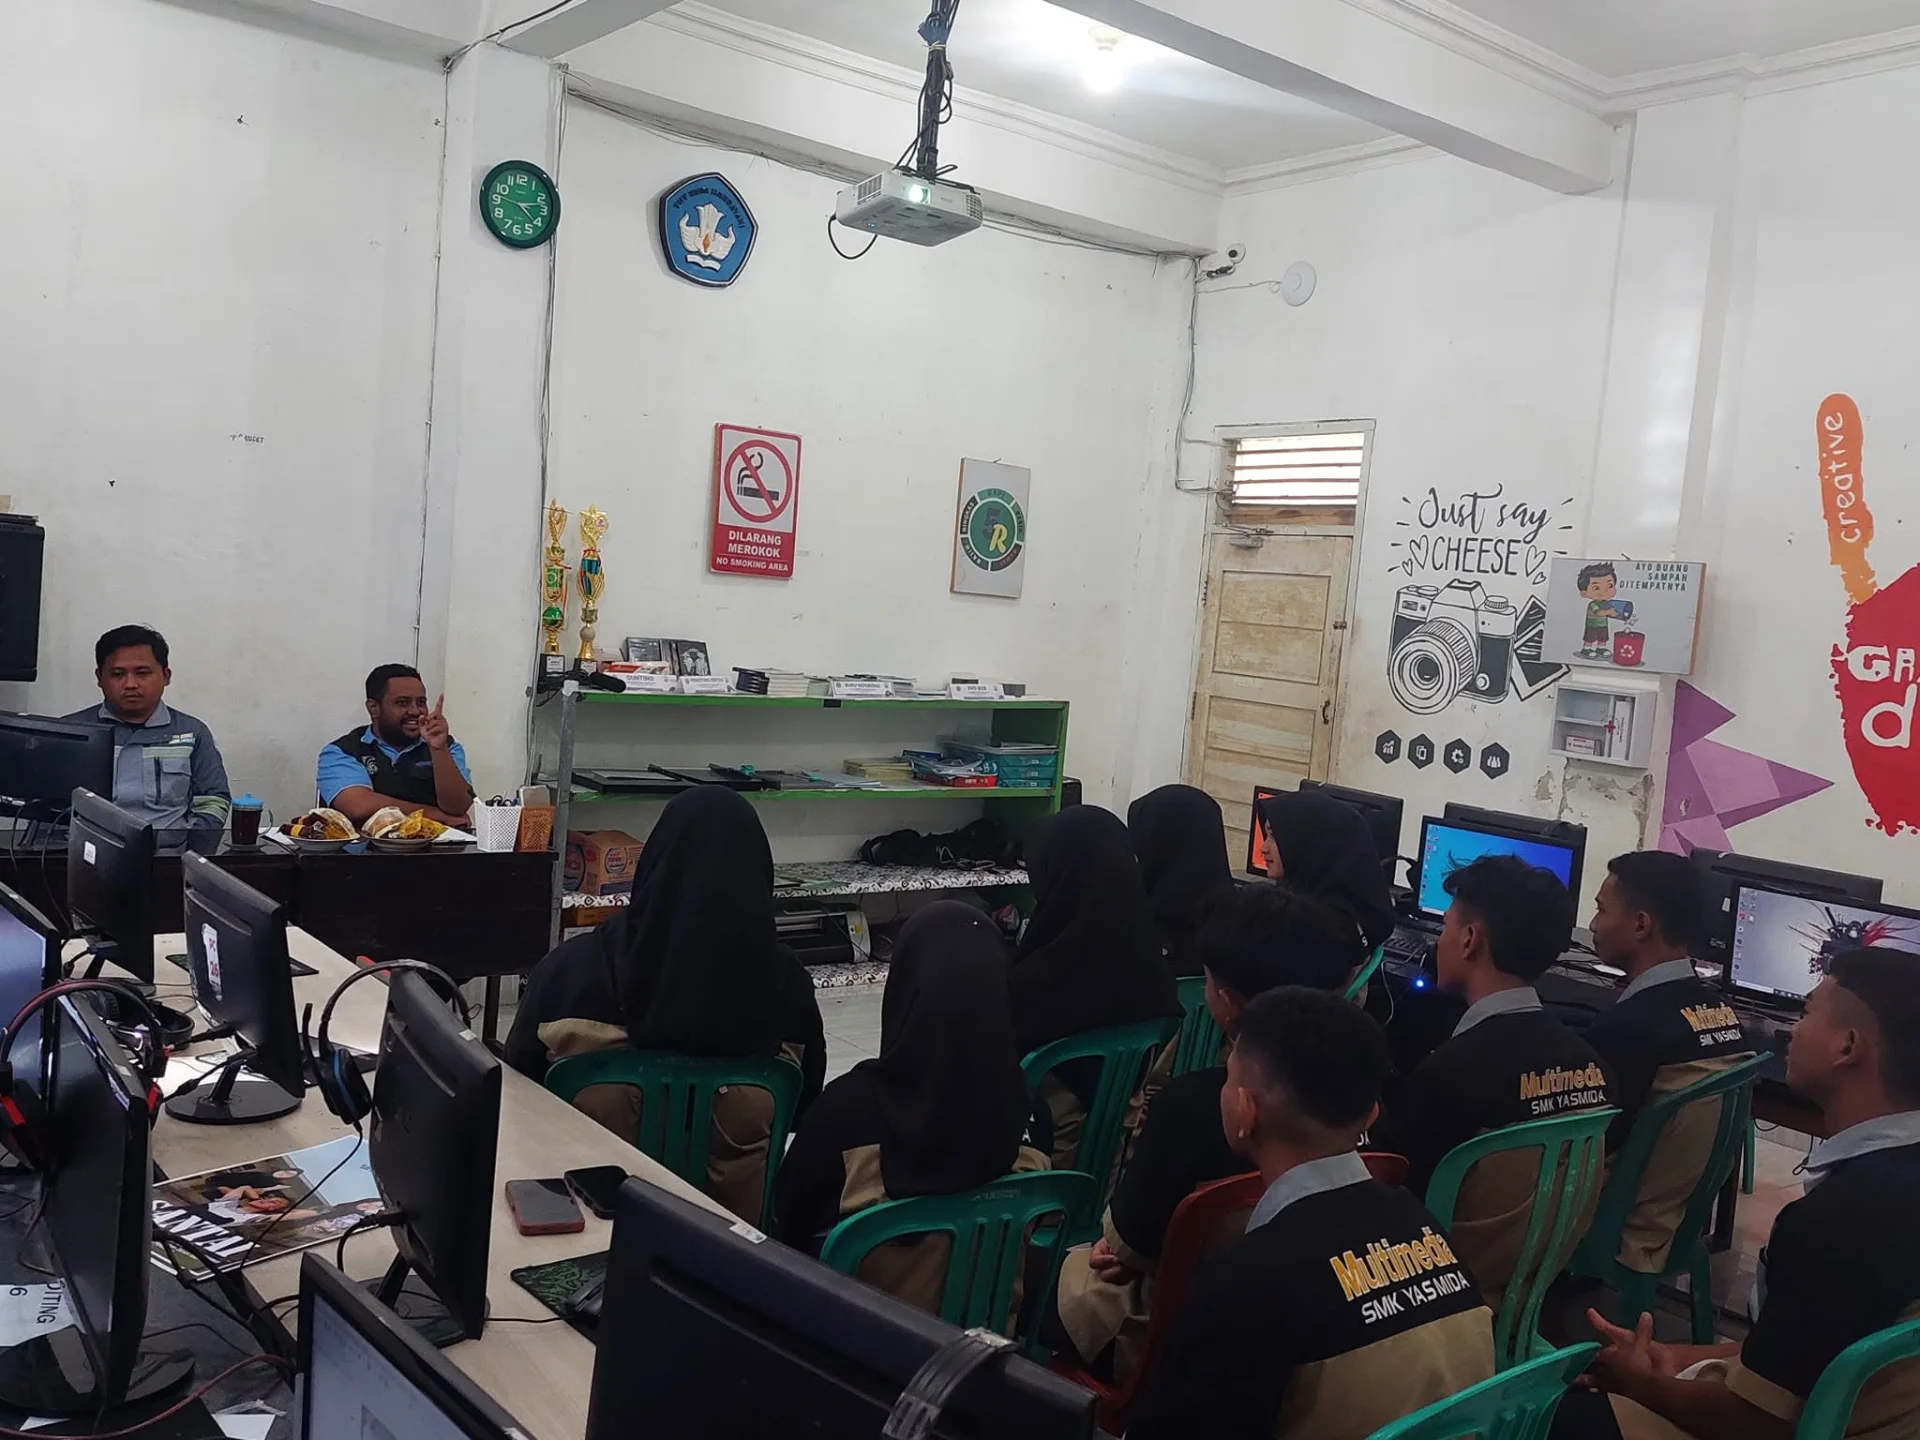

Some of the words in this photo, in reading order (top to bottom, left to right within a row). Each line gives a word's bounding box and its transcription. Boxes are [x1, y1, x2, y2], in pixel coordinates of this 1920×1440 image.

[507, 174, 514, 186] 11
[516, 174, 528, 186] 12
[532, 180, 536, 191] 1
[496, 183, 510, 195] 10
[492, 194, 502, 205] 9
[537, 192, 546, 204] 2
[494, 207, 504, 218] 8
[540, 204, 548, 216] 3
[503, 218, 513, 229] 7
[533, 217, 542, 227] 4
[512, 224, 521, 235] 6
[524, 223, 533, 234] 5
[1824, 411, 1862, 543] creative
[1418, 482, 1503, 535] Just
[1496, 502, 1552, 544] say
[728, 530, 782, 546] DILARANG
[727, 543, 781, 558] MEROKOK
[1431, 536, 1522, 576] CHEESE
[716, 556, 729, 565] NO
[730, 558, 767, 569] SMOKING
[768, 562, 789, 572] AREA
[1635, 563, 1653, 571] AYO
[1656, 563, 1689, 573] BUANG
[1647, 572, 1688, 582] SAMPAH
[1619, 580, 1686, 592] DITEMPATNYA
[1520, 1061, 1607, 1100] Multimedia
[1531, 1096, 1555, 1115] SMK
[1557, 1089, 1607, 1109] YASMIDA
[1329, 1225, 1459, 1302] Multimedia
[1361, 1291, 1405, 1325] SMK
[1401, 1269, 1471, 1307] YASMIDA
